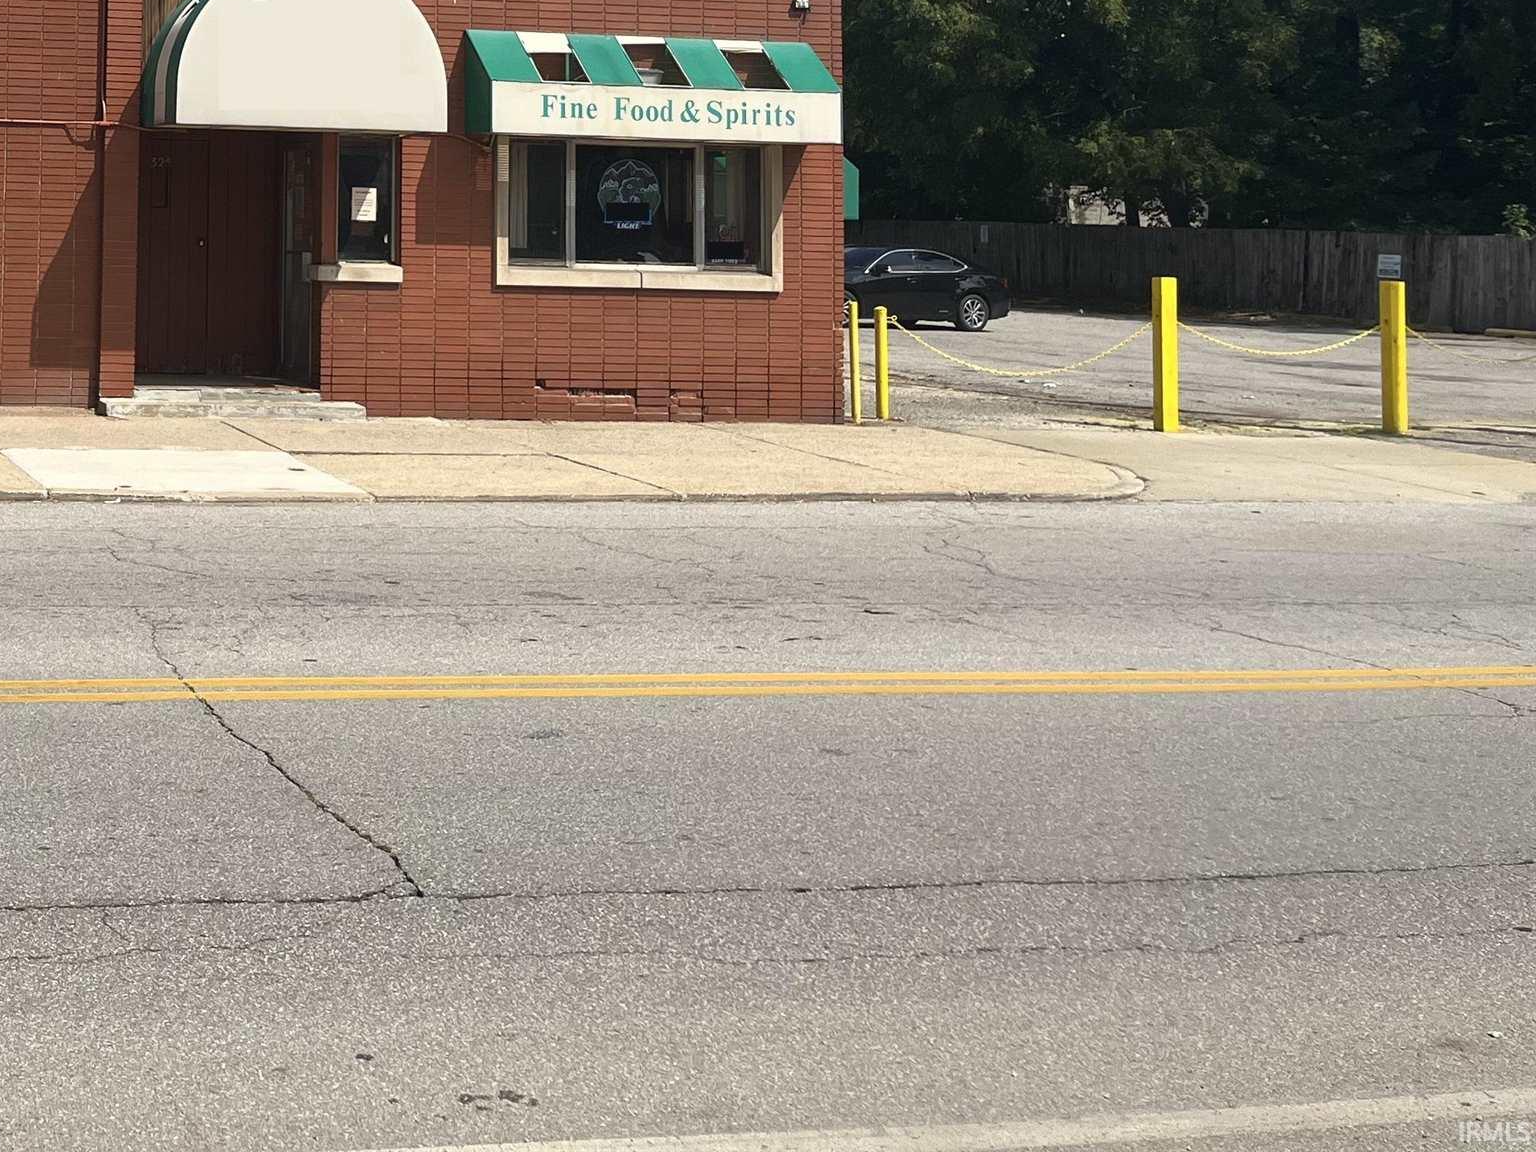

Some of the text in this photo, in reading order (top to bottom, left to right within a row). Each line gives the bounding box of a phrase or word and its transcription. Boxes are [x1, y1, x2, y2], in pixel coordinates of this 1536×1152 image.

[540, 94, 796, 130] Fine Food & Spirits
